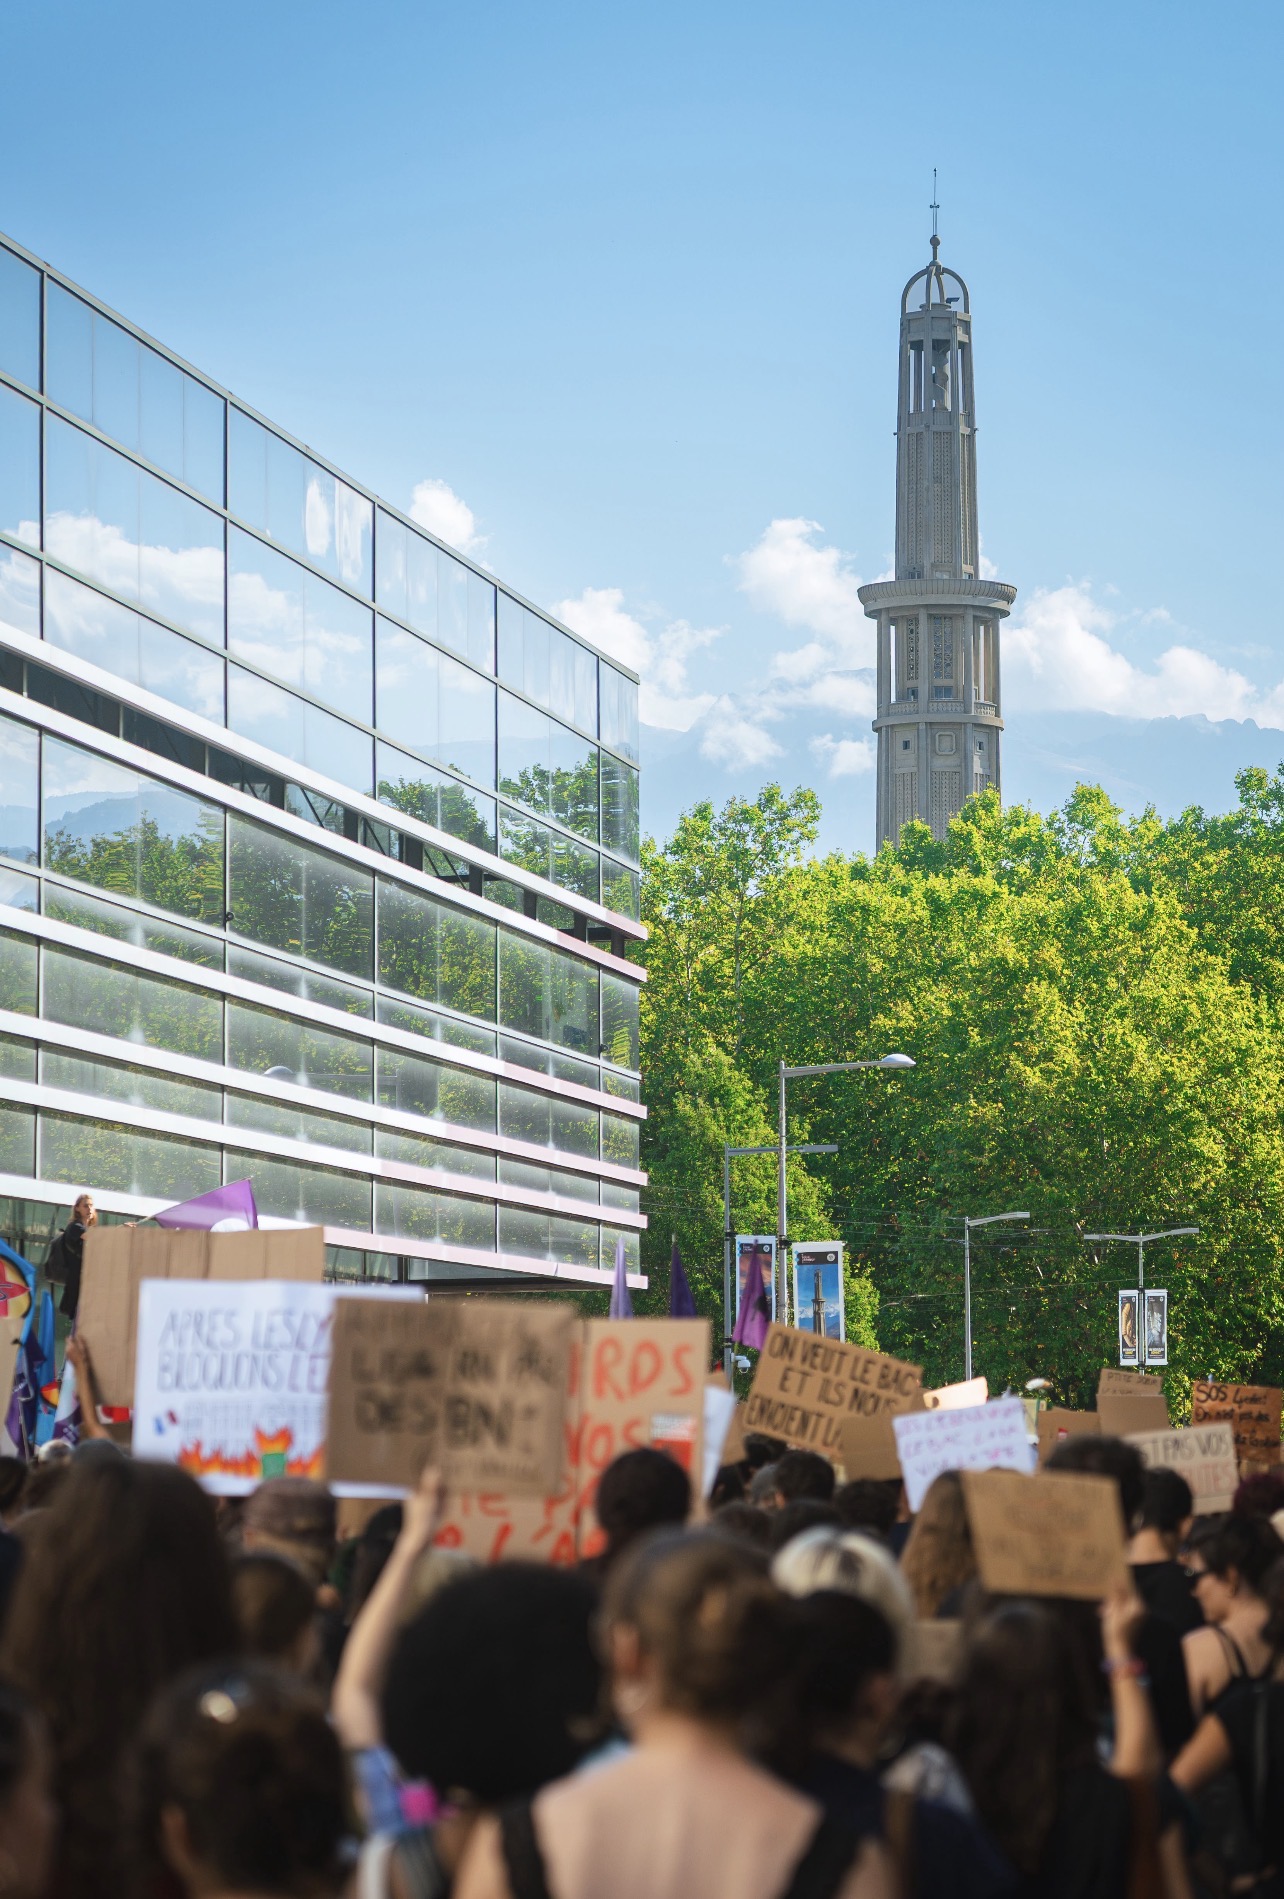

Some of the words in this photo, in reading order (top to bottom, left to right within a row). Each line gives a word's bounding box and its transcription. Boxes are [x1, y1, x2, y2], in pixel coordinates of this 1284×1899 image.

[769, 1331, 798, 1362] ON
[800, 1336, 847, 1376] VEUT
[850, 1353, 878, 1385] LE
[876, 1362, 916, 1397] BAC
[779, 1365, 813, 1396] ET
[1196, 1382, 1229, 1404] SOS
